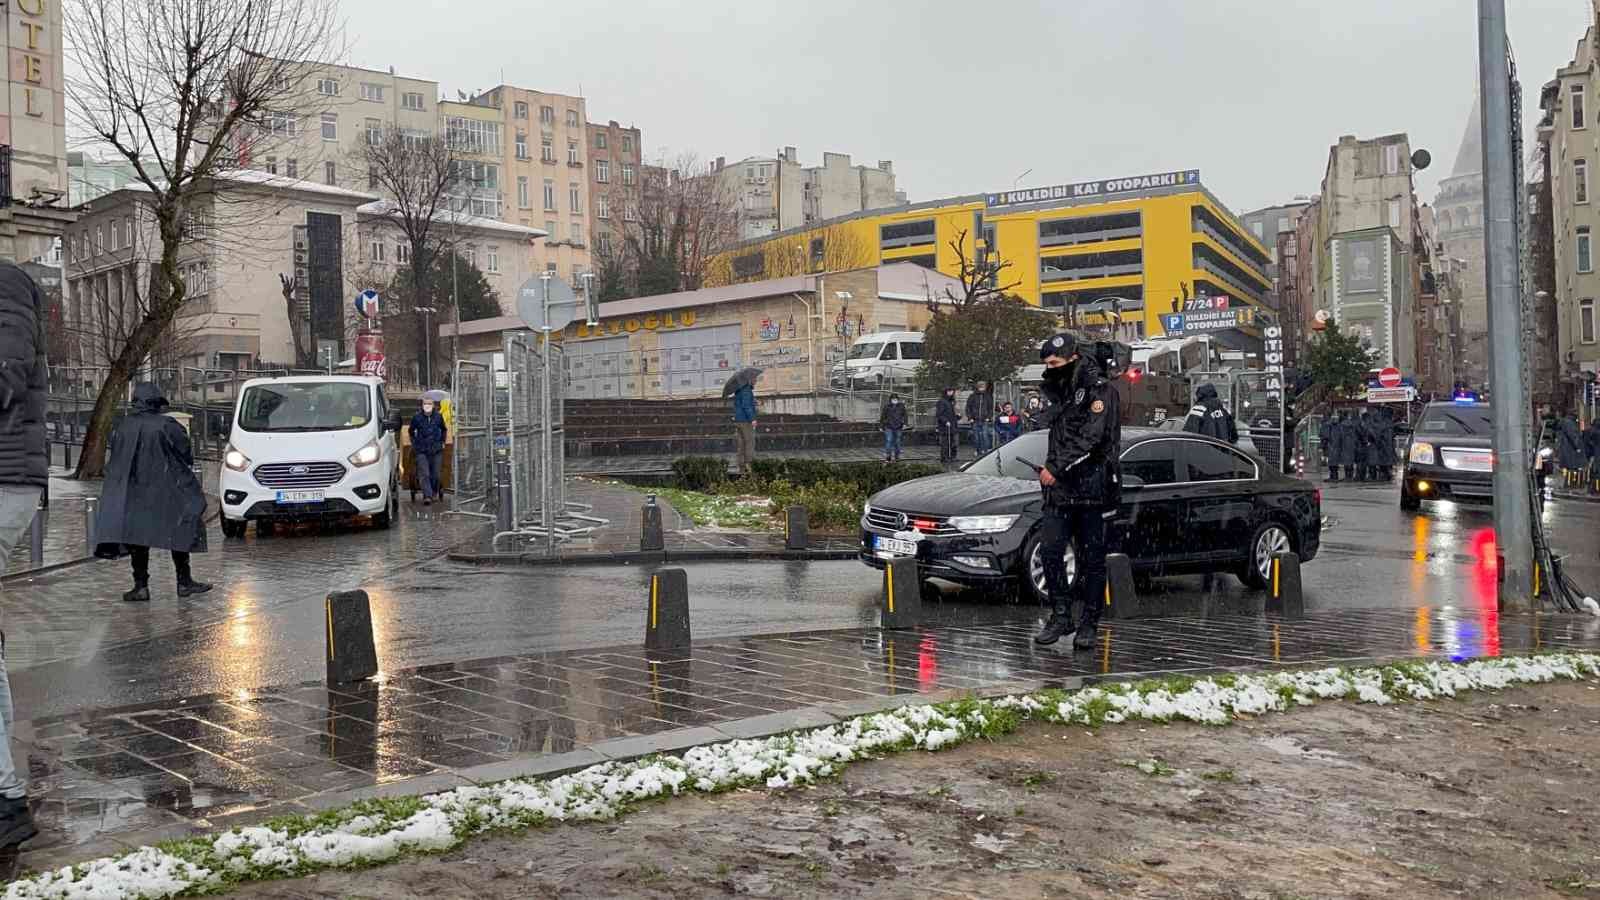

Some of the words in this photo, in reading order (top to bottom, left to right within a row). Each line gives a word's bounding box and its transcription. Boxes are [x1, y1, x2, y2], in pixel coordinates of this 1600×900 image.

[1106, 173, 1176, 191] OTOPARKI
[1186, 300, 1213, 310] 7/24
[1216, 297, 1225, 309] P
[1170, 316, 1180, 329] P
[1186, 319, 1236, 330] OTOPARKI
